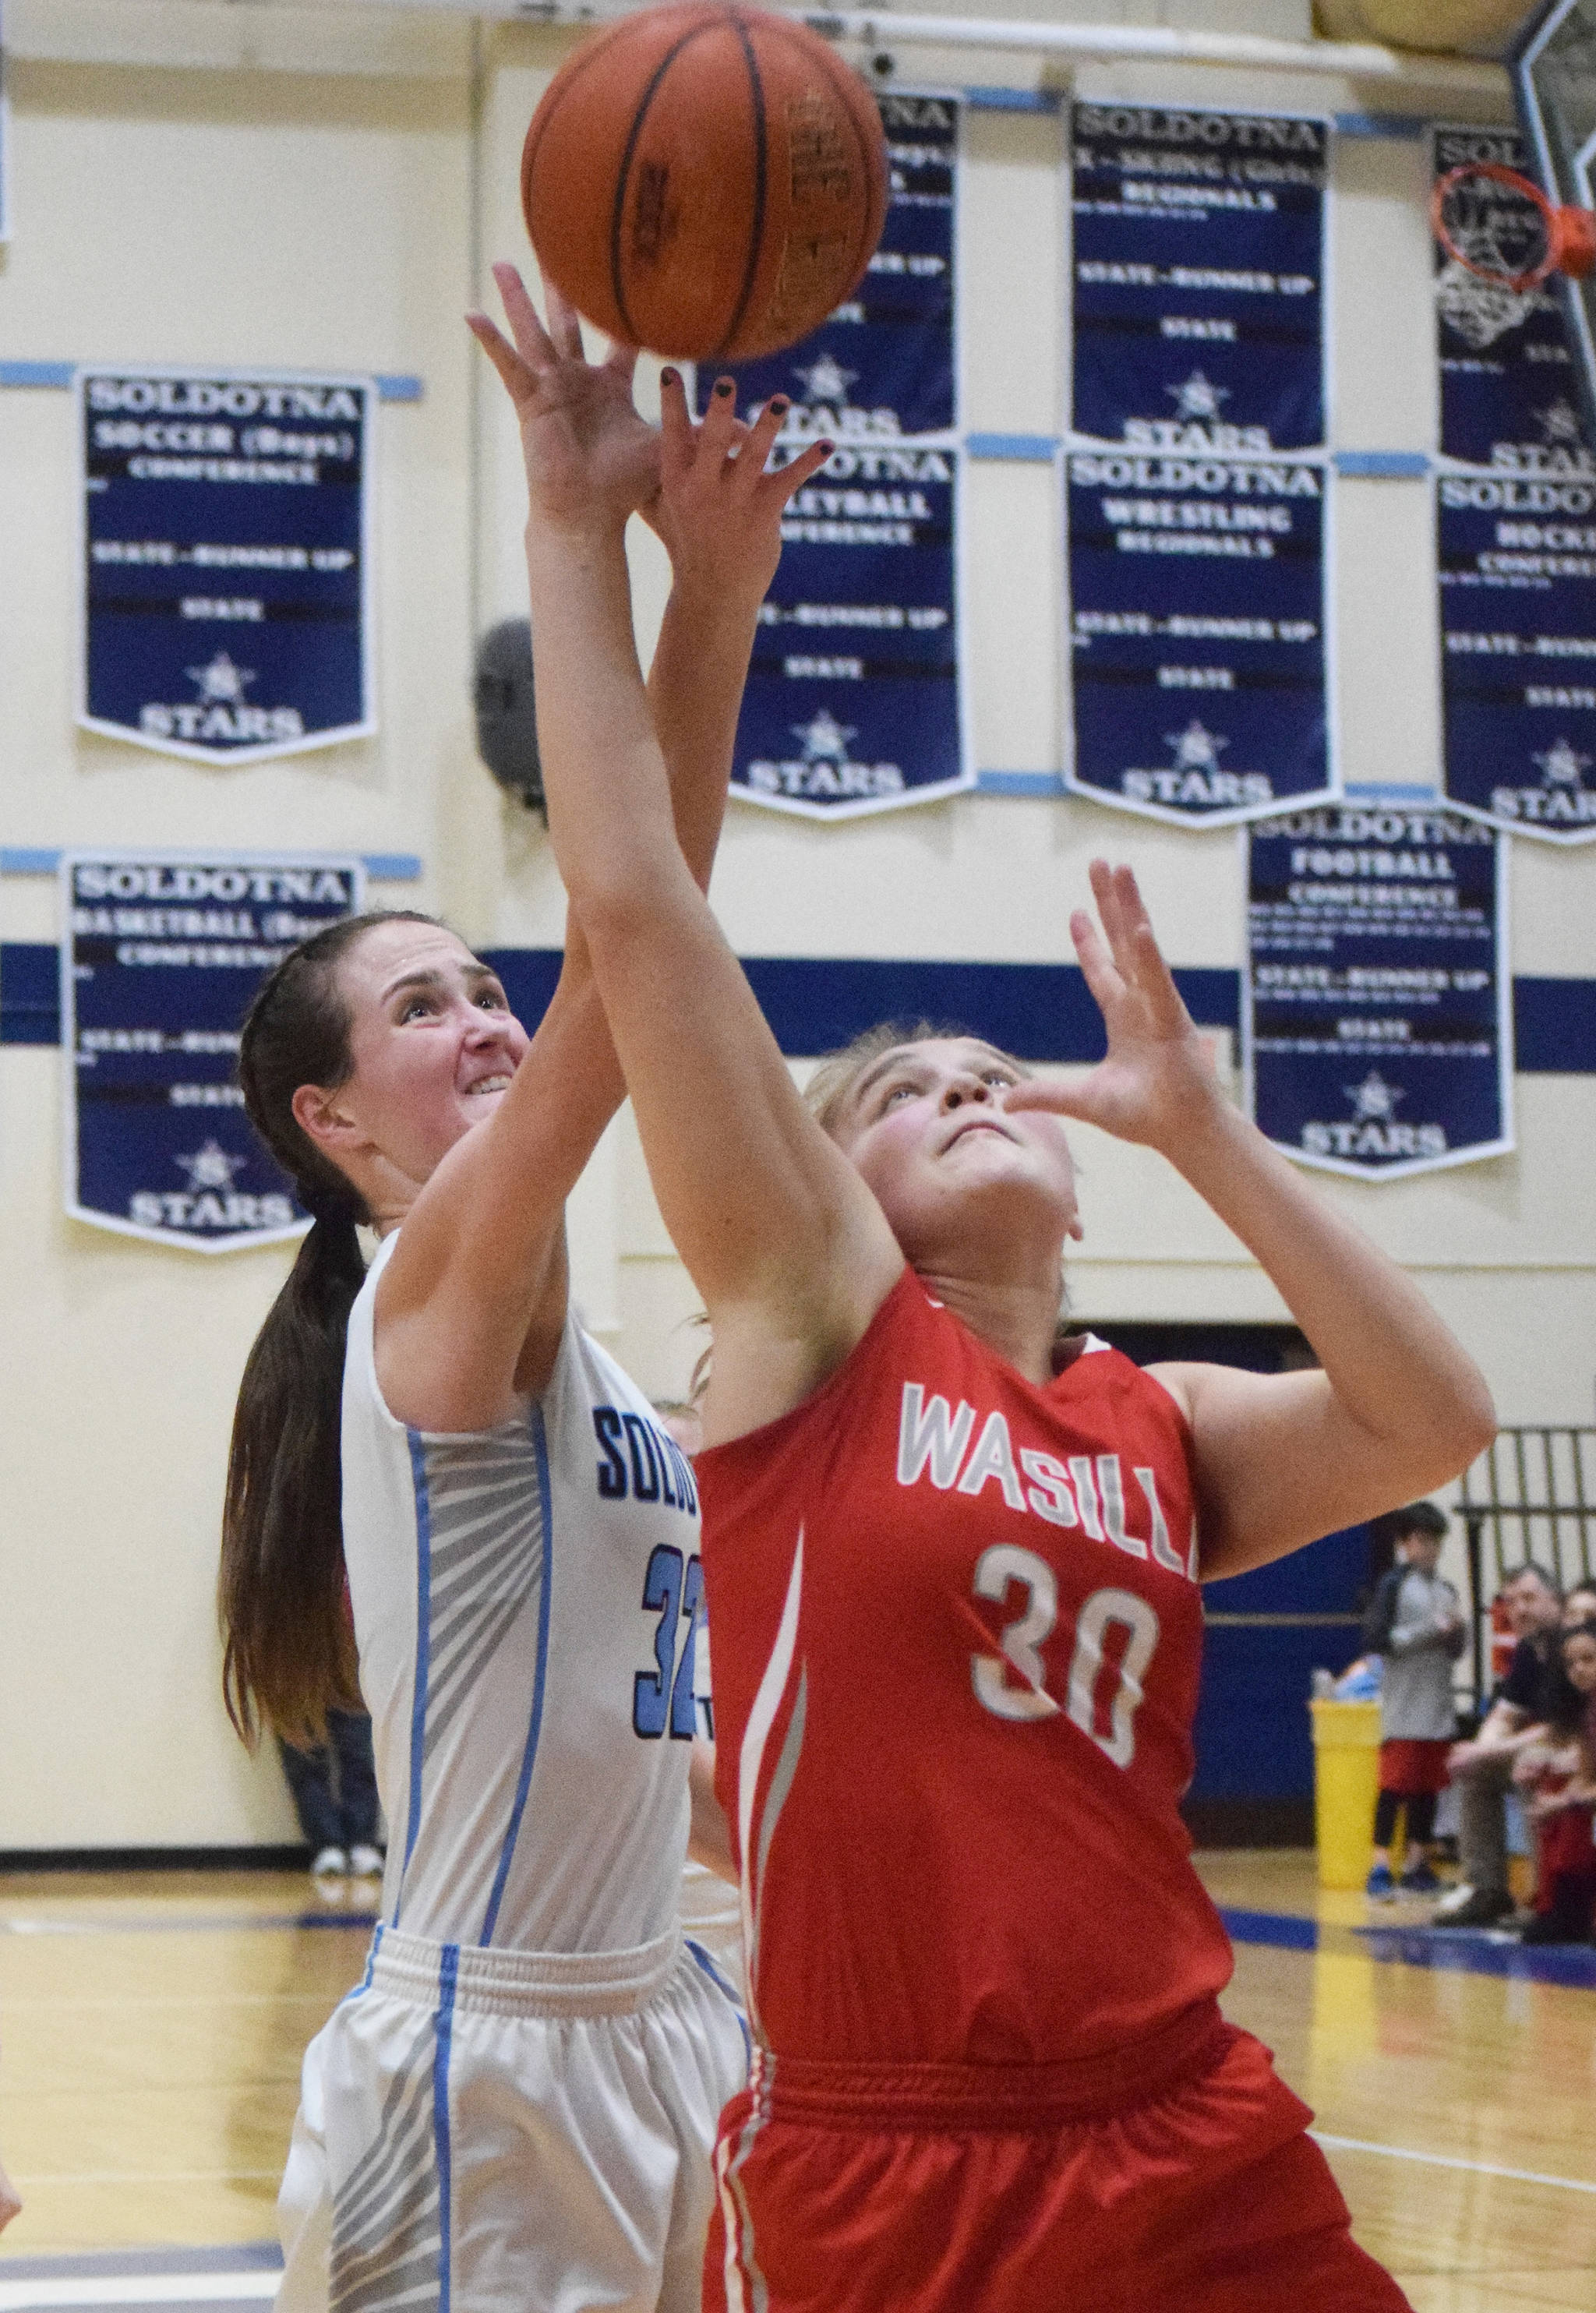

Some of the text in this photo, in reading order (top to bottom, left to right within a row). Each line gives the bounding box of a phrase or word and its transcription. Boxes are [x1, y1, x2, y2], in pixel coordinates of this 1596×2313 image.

[1075, 106, 1320, 150] SOLDOTNA
[89, 380, 361, 418] SOLDOTNA
[93, 420, 234, 453] SOCCER
[1123, 416, 1272, 454] STARS
[1070, 457, 1321, 496] SOLDOTNA
[1103, 497, 1292, 533] WRESTLING
[1439, 479, 1595, 516] SOLDO
[138, 704, 305, 742] STARS
[747, 761, 904, 796] STARS
[1121, 768, 1273, 807] STARS
[1491, 787, 1596, 825] STAR
[1254, 810, 1492, 845] SOLDOTNA
[1291, 848, 1456, 879] FOOTBALL
[77, 867, 348, 902] SOLDOTNA
[72, 909, 256, 938] BASKETBALL
[1302, 1122, 1448, 1158] STARS
[129, 1192, 293, 1228] STARS
[633, 1543, 707, 1741] 32
[971, 1544, 1160, 1770] 30
